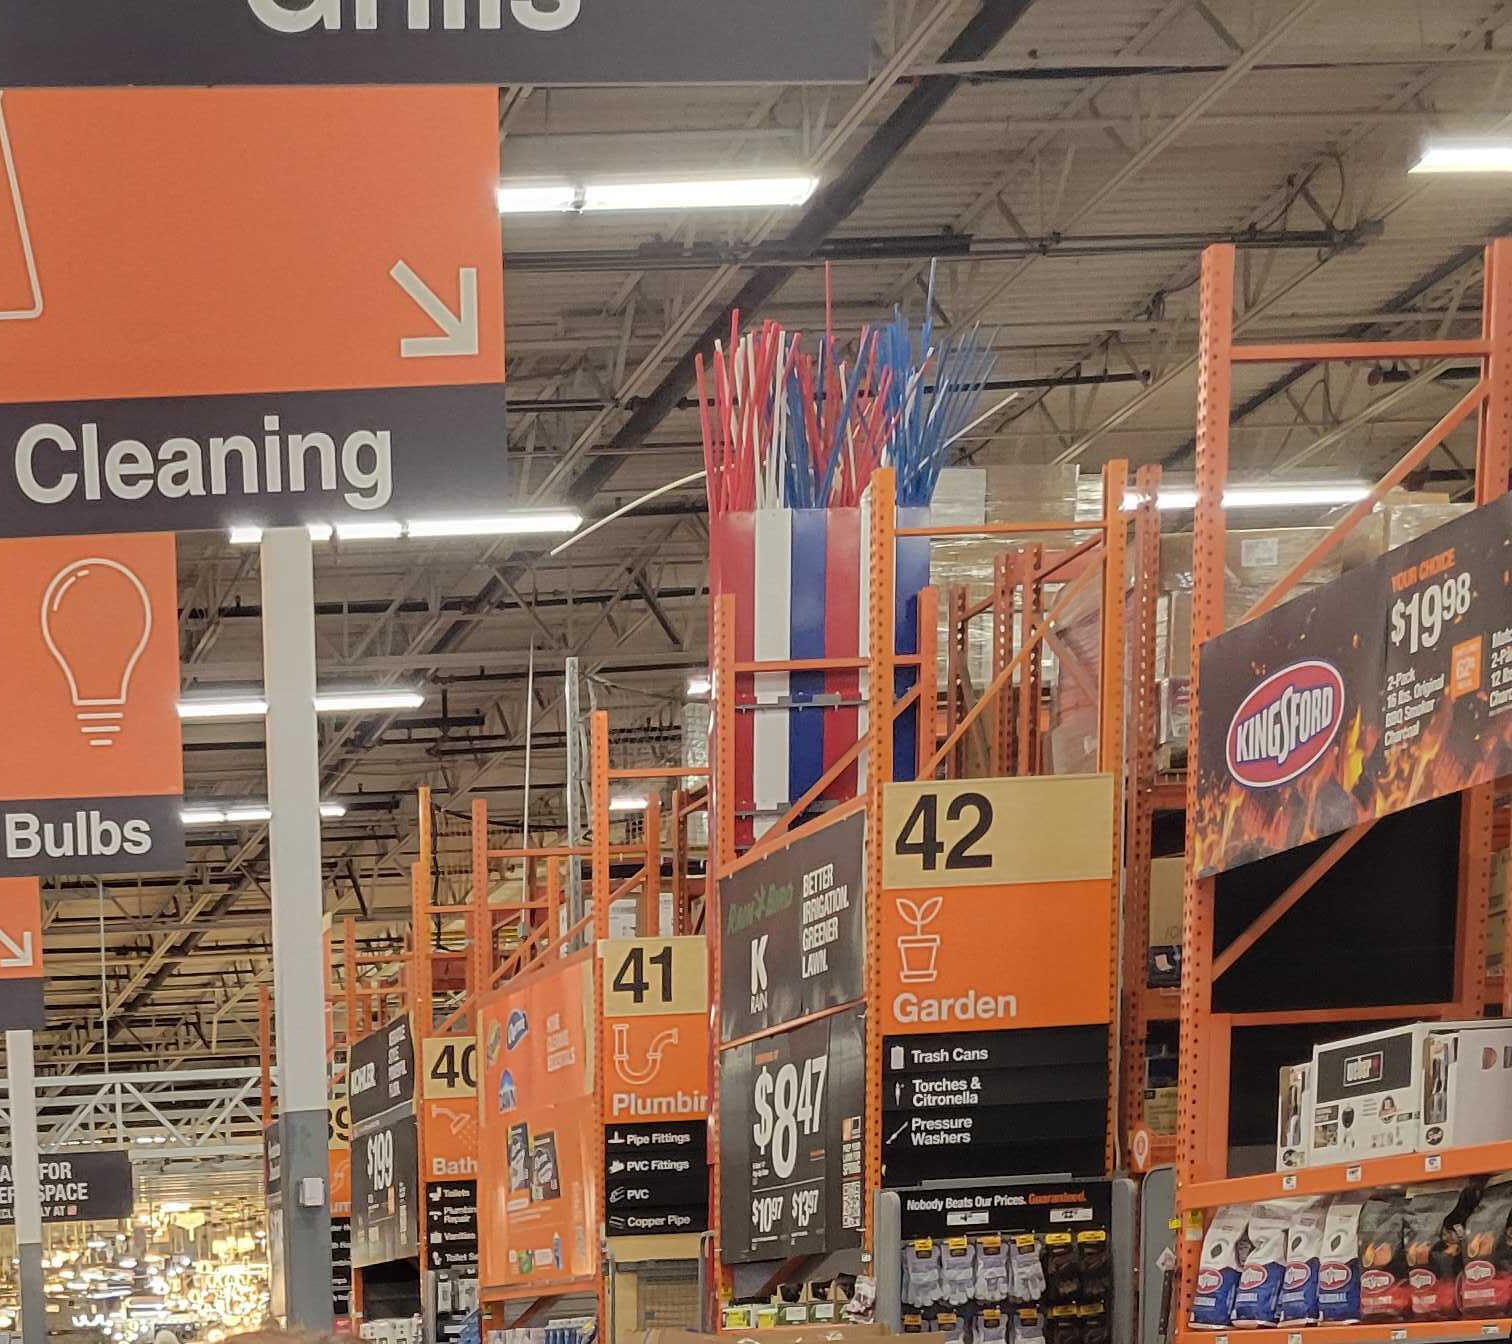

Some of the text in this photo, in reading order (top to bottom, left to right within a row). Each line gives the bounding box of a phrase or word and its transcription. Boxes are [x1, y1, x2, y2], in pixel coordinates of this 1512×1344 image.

[15, 415, 393, 510] Cleaning
[1236, 685, 1334, 766] KINGSFORD
[6, 811, 152, 857] Bulbs
[895, 792, 994, 870] 42
[803, 863, 833, 898] BETTER
[803, 917, 838, 951] GREENER
[751, 934, 769, 994] K
[613, 946, 673, 1003] 41
[894, 990, 1017, 1023] Garden
[911, 1047, 989, 1064] Trash Cans
[912, 1076, 982, 1093] Torches &
[613, 1091, 707, 1116] Plumbin
[912, 1091, 979, 1107] Citronella
[753, 1054, 827, 1179] $847
[911, 1117, 973, 1131] Pressure
[626, 1131, 691, 1148] Pipe Fittings
[911, 1131, 972, 1146] Washers
[39, 1161, 72, 1180] FOR
[432, 1157, 477, 1175] Bath
[626, 1158, 690, 1173] PVC Fittings
[626, 1188, 650, 1200] PVC
[906, 1197, 944, 1212] Nobody
[945, 1196, 973, 1210] Beats
[974, 1195, 992, 1208] Our
[994, 1193, 1027, 1207] Prices.
[627, 1213, 691, 1230] Copper Pipe
